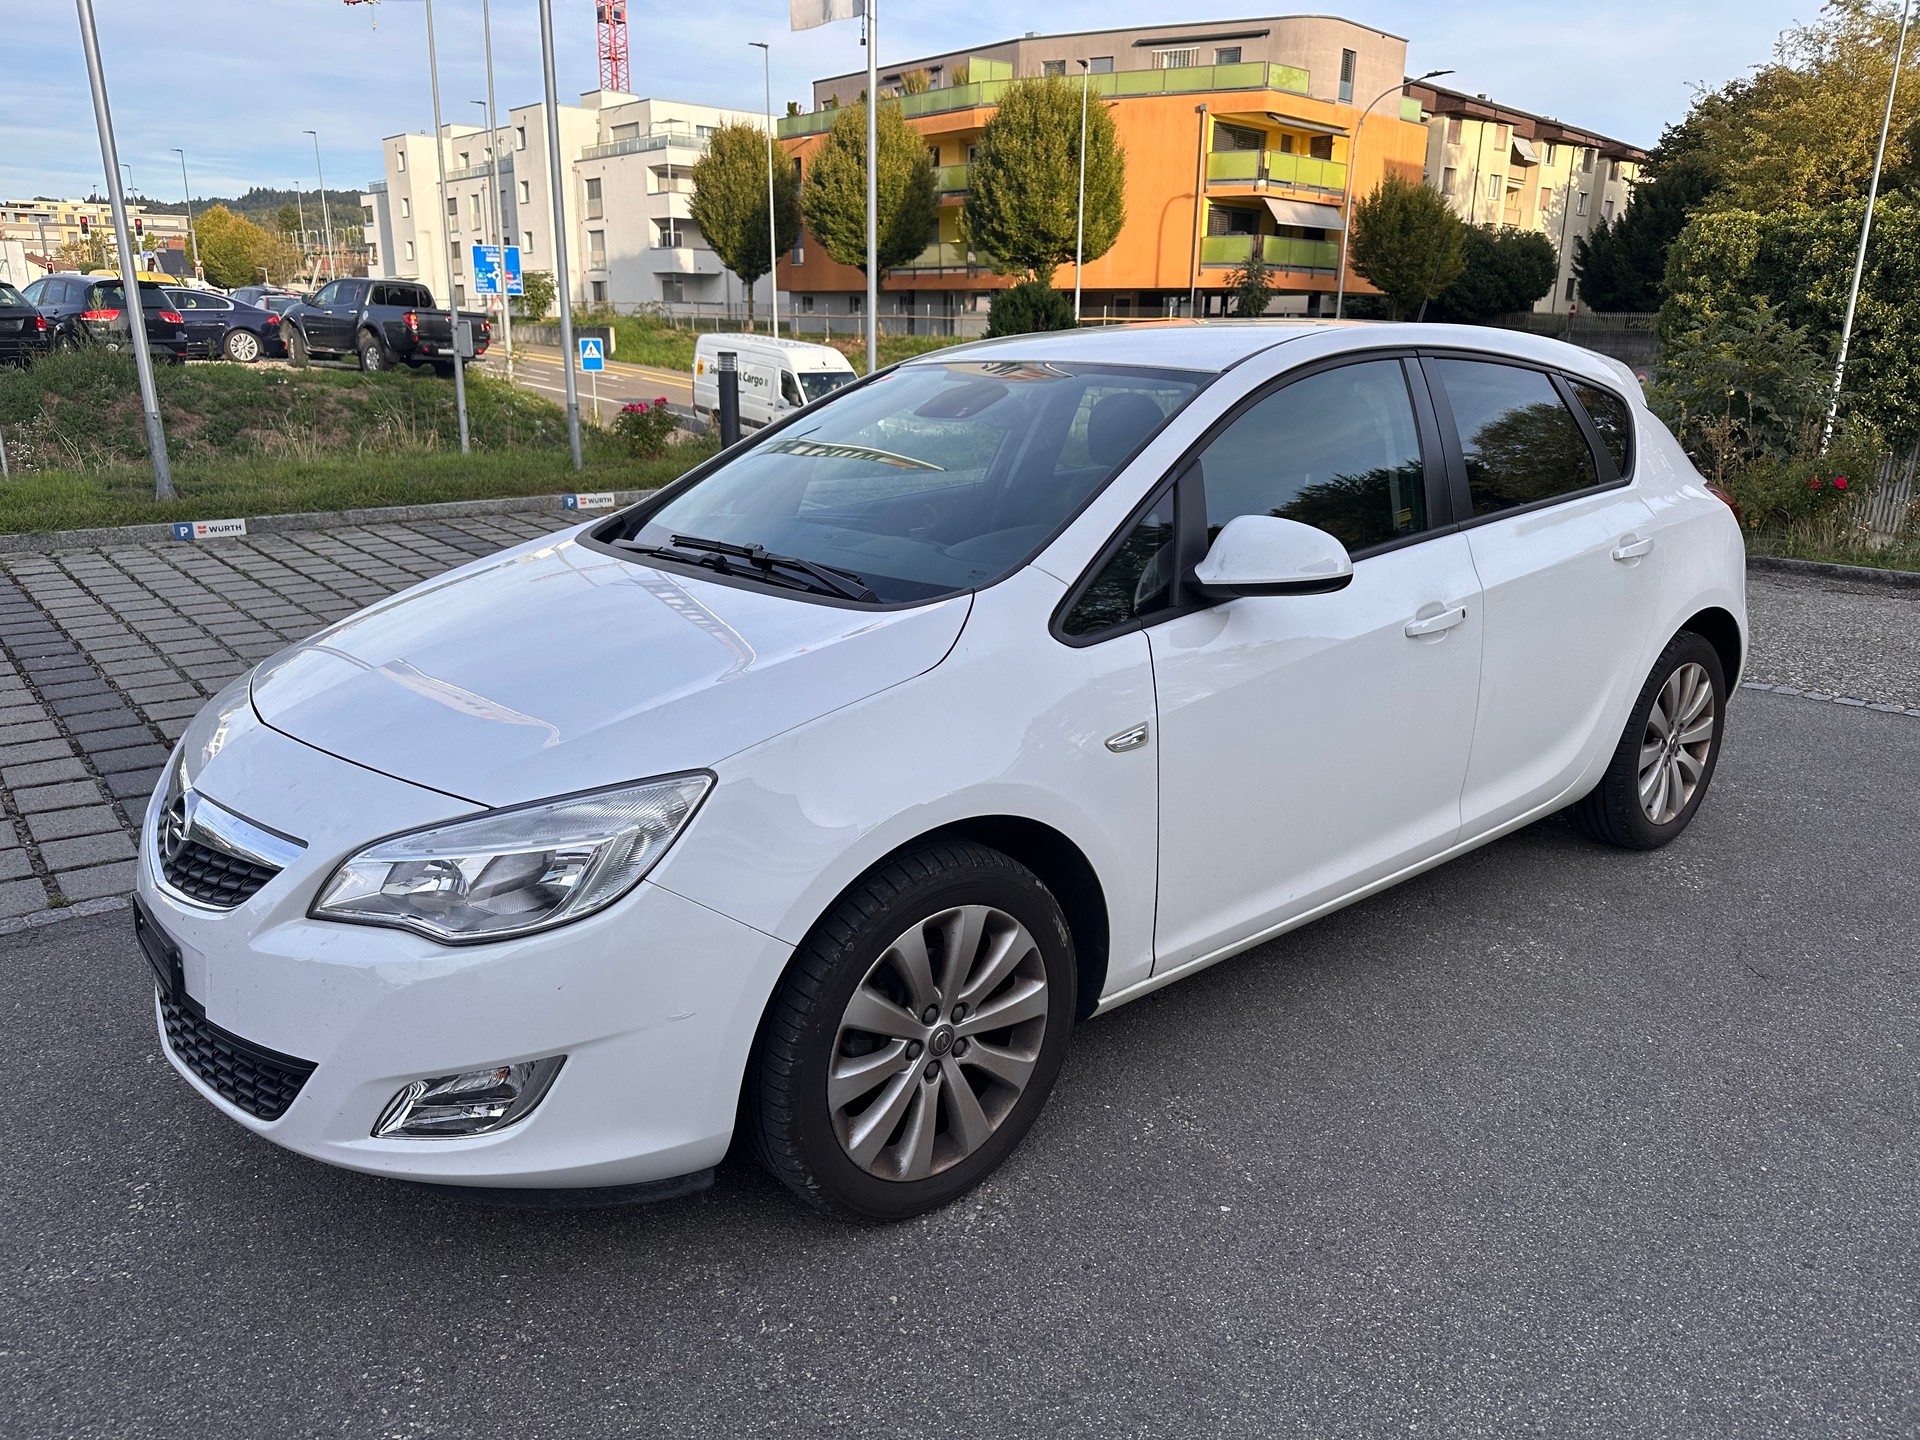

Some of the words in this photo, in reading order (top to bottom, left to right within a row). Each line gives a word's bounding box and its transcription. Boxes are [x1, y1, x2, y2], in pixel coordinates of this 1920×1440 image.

[743, 371, 764, 387] Cargo
[567, 497, 575, 507] P
[179, 526, 189, 537] P
